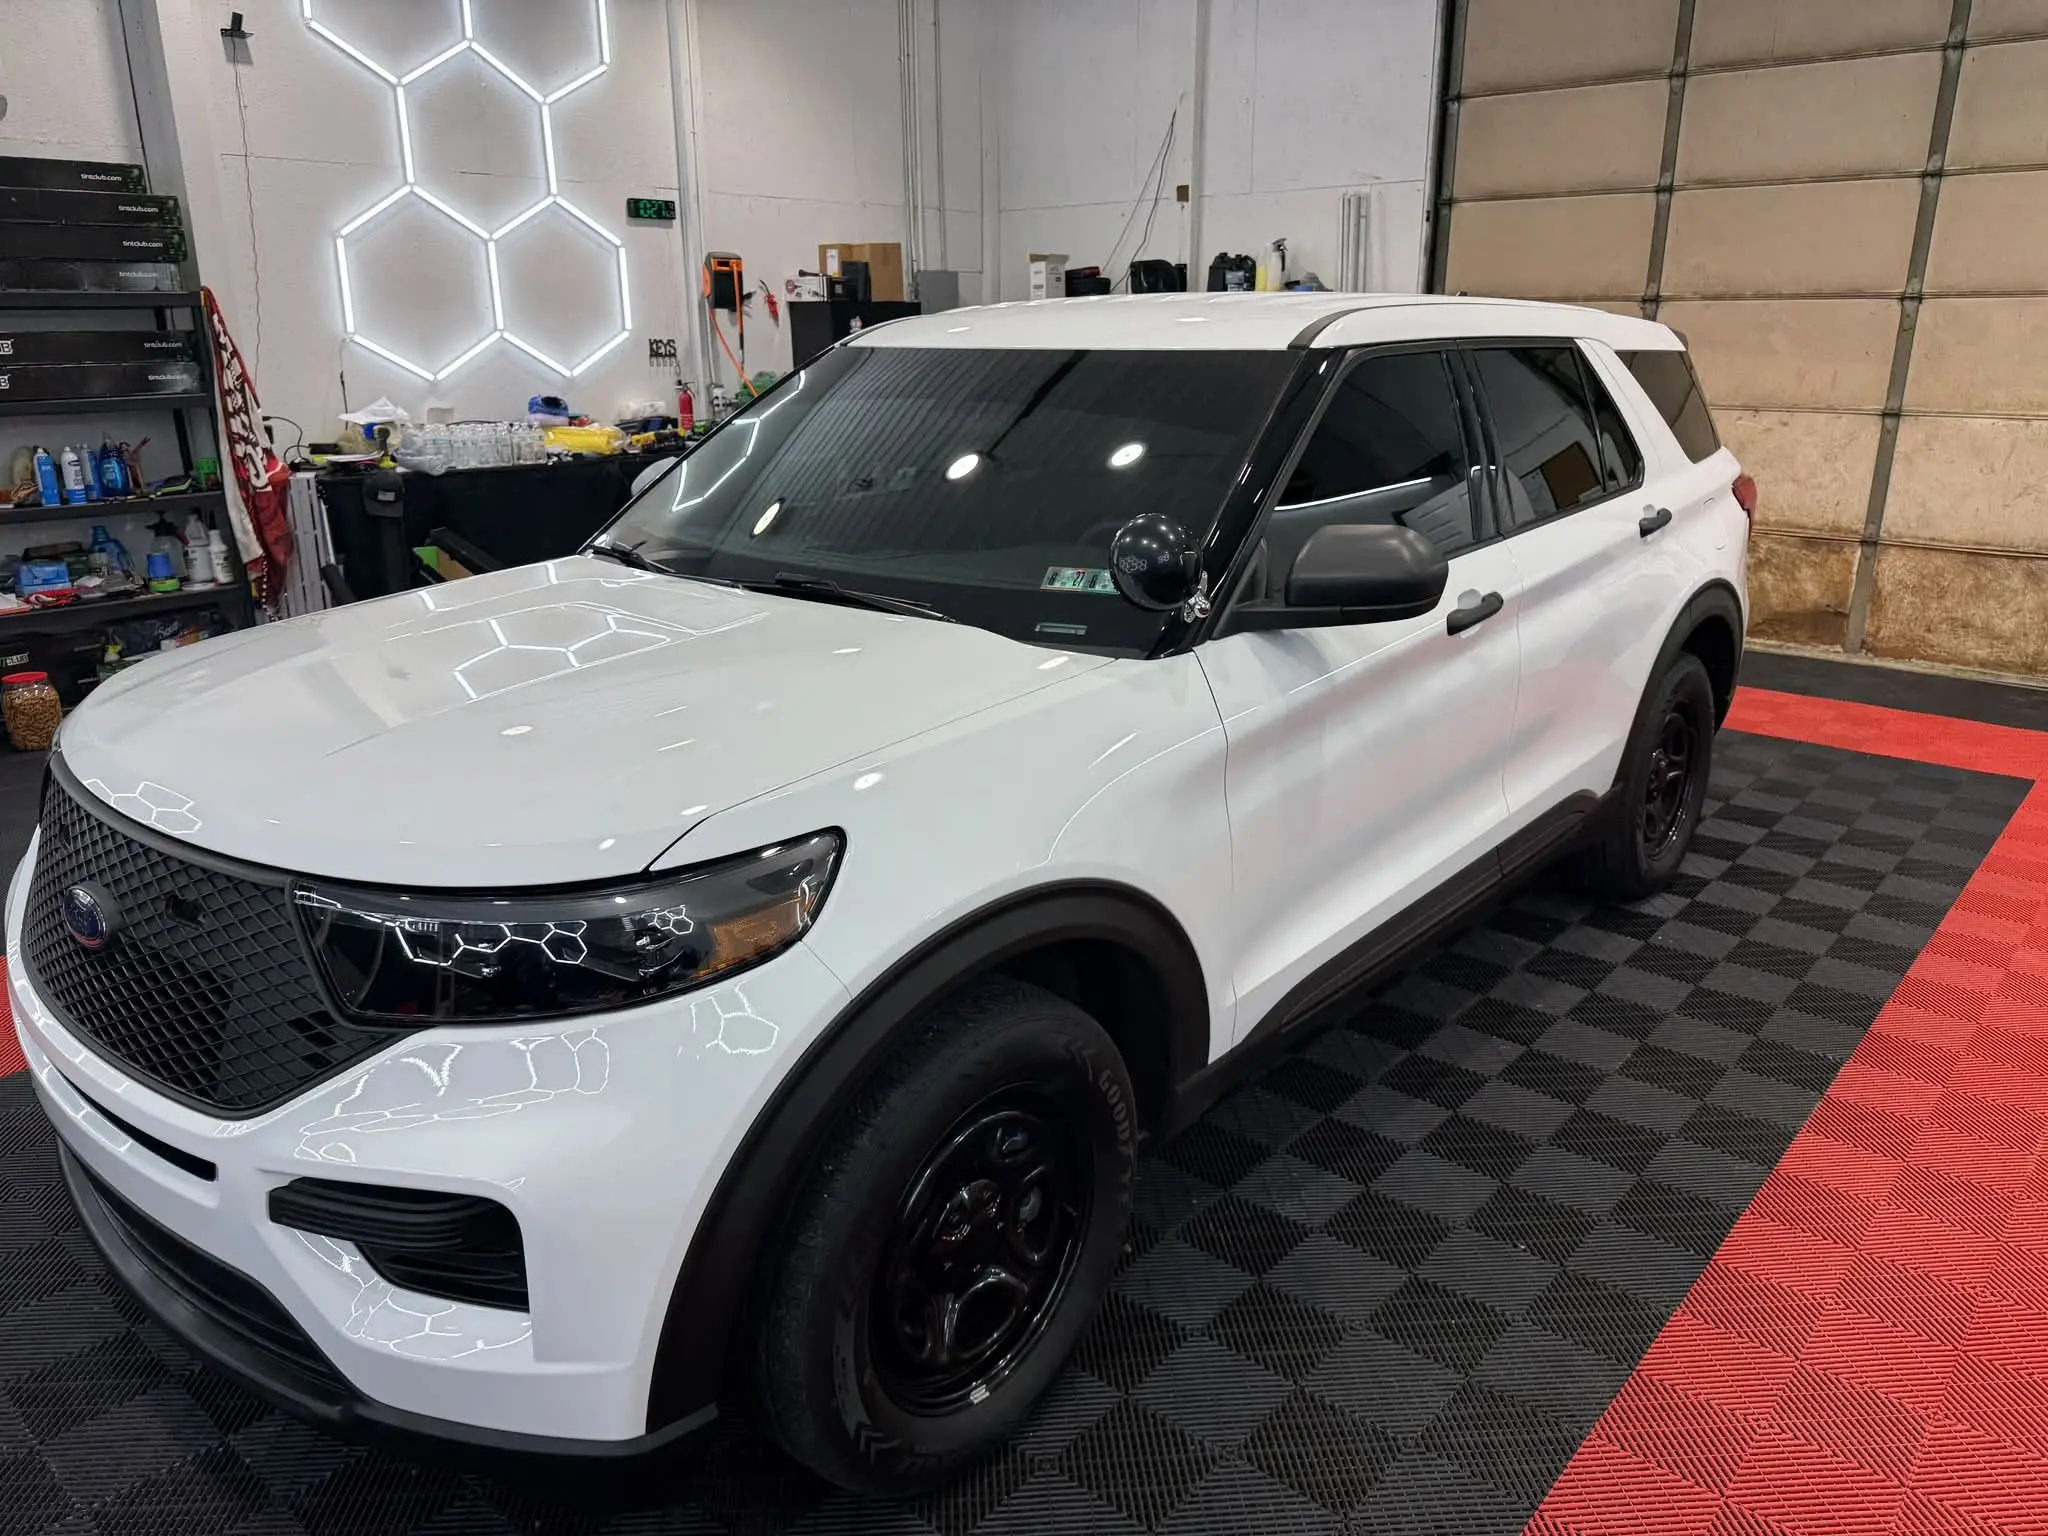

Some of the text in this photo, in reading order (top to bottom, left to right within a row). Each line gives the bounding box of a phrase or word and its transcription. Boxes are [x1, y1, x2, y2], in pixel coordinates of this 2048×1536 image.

[80, 173, 122, 182] tintclub.com
[118, 205, 159, 213] tintclub.com
[122, 240, 164, 249] tintclub.com
[648, 338, 677, 357] KEYS
[1072, 571, 1086, 587] 27
